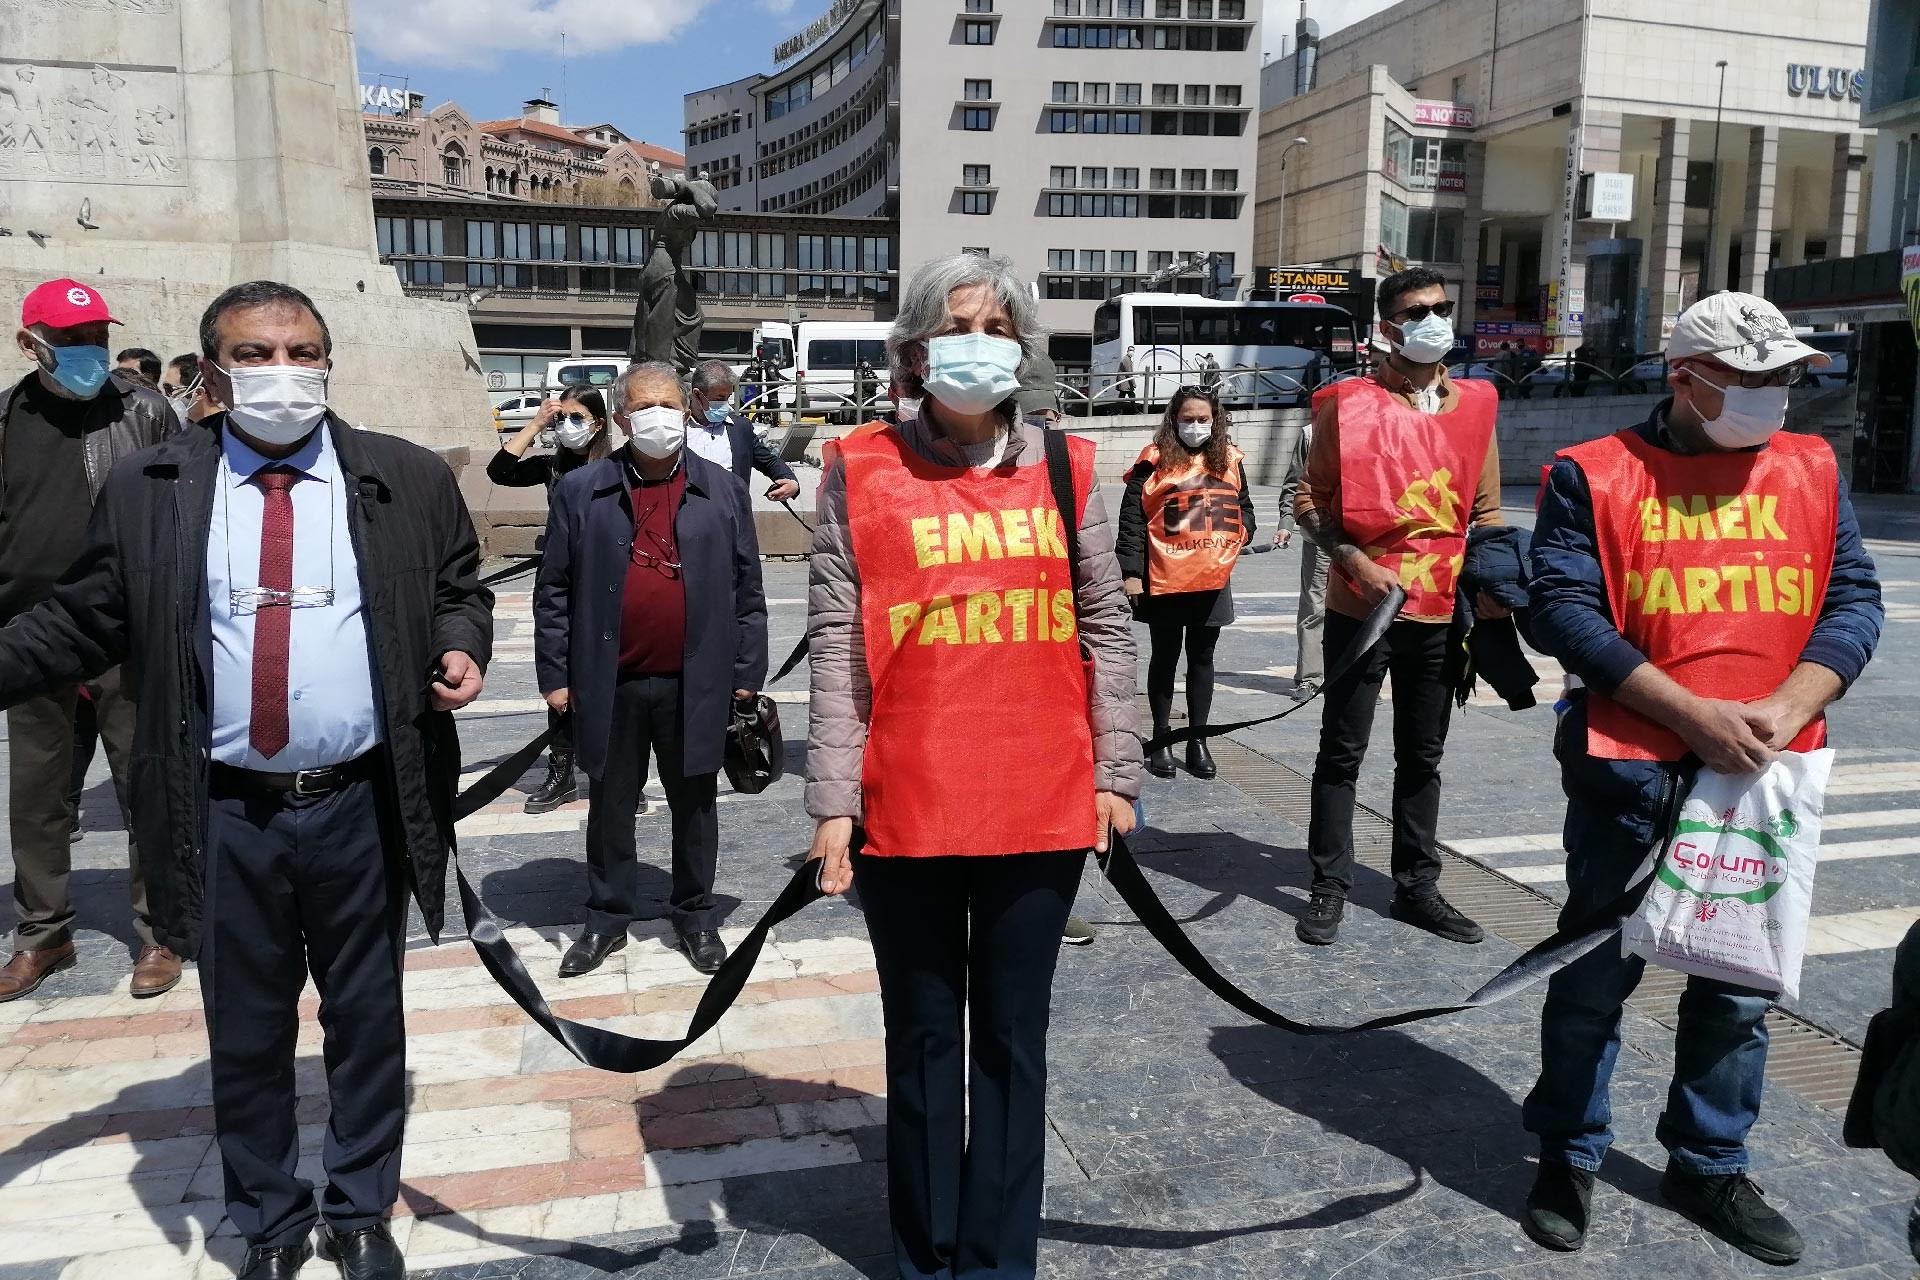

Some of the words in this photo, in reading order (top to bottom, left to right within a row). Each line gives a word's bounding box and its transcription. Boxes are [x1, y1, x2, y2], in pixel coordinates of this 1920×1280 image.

[360, 85, 410, 110] KASI
[1787, 63, 1863, 102] ULUS
[1430, 109, 1473, 123] NOTER
[1440, 178, 1464, 188] NOTER
[1638, 494, 1788, 542] EMEK
[911, 507, 1068, 569] EMEK
[1673, 841, 1766, 877] Çorum
[1721, 872, 1763, 889] Konağı
